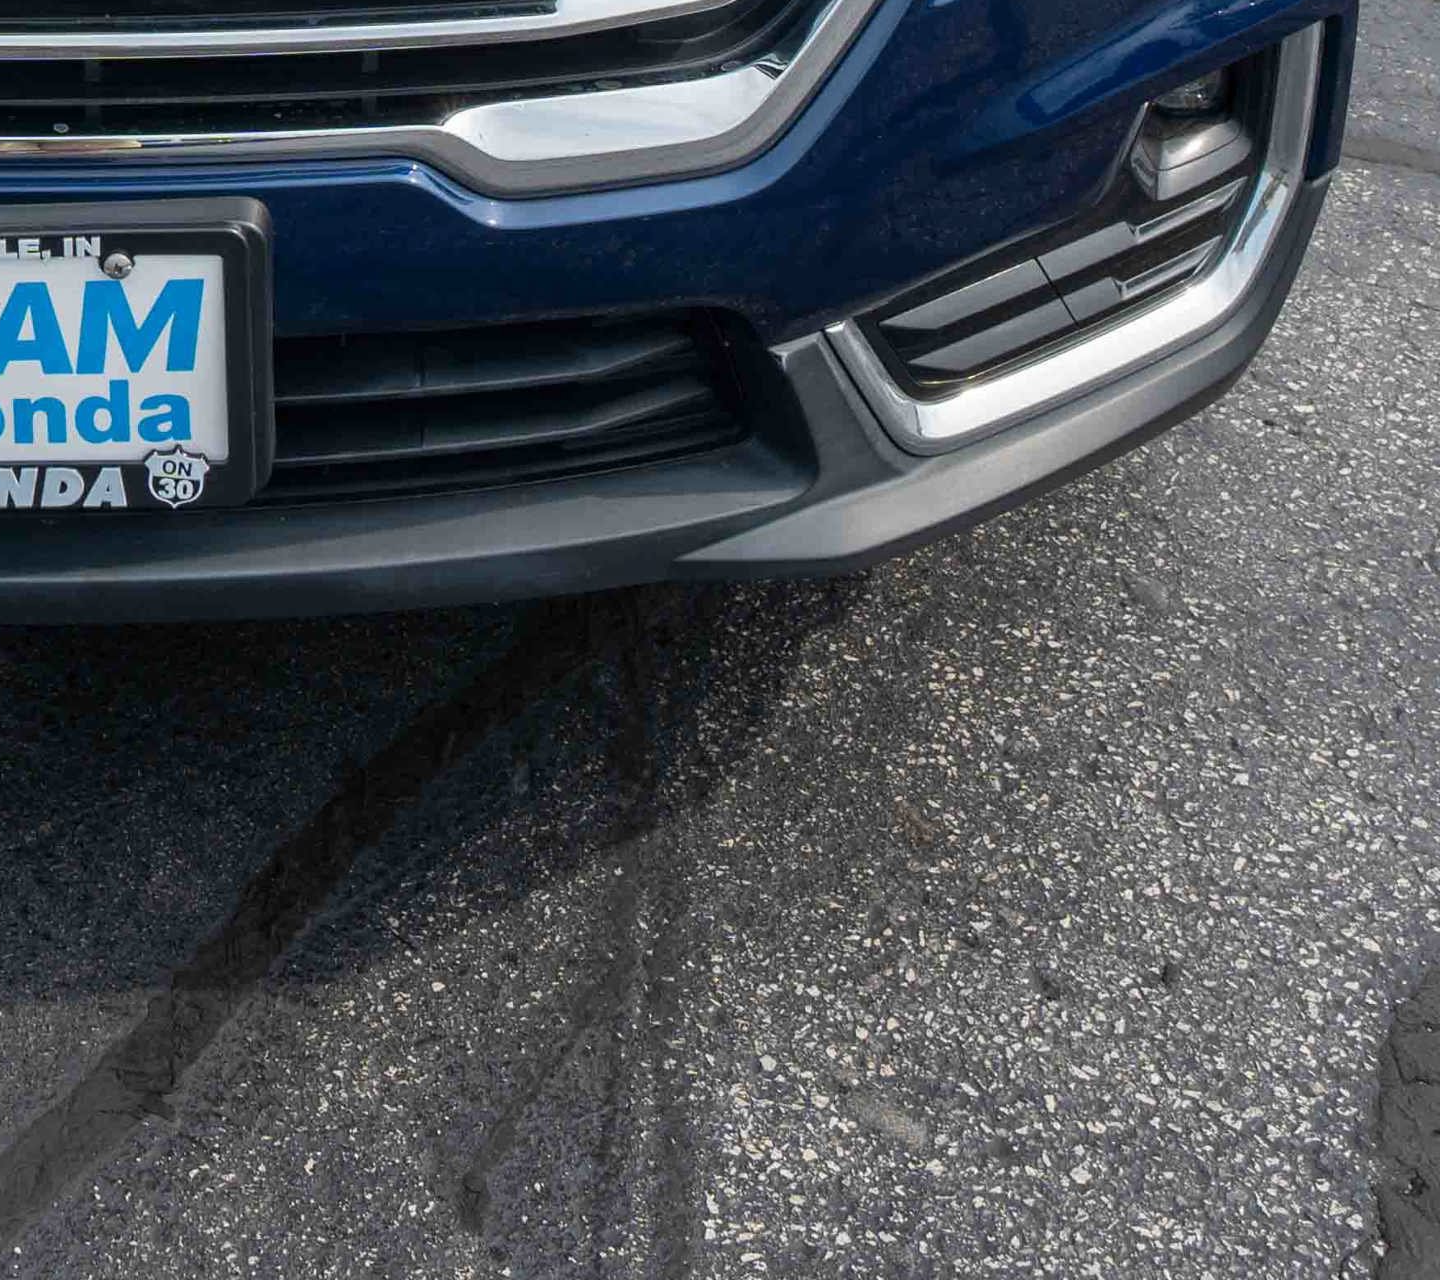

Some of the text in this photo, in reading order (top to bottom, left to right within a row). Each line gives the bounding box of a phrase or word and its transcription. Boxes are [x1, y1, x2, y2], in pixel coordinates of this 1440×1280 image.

[62, 236, 101, 260] IN
[162, 460, 192, 478] ON
[158, 477, 194, 500] 30
